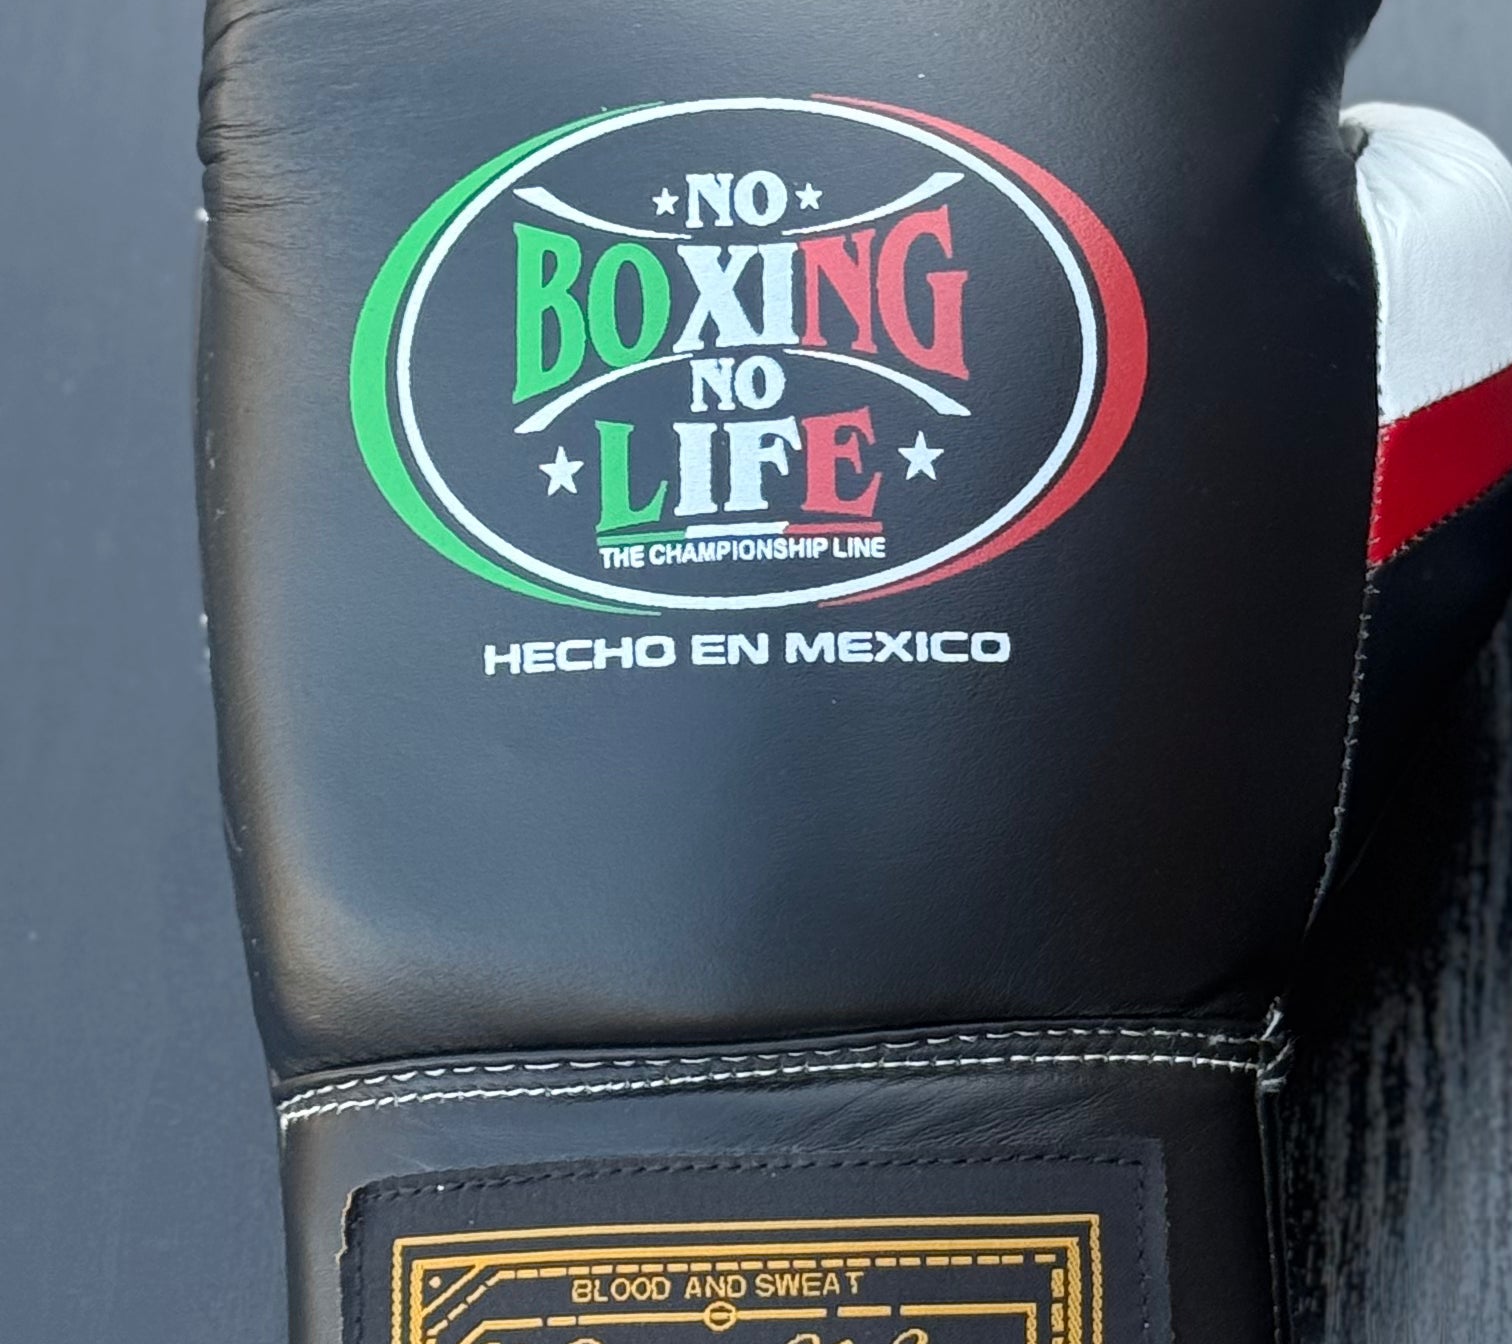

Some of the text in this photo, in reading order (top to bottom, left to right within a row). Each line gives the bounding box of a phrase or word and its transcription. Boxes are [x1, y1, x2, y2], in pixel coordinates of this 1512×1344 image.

[685, 170, 788, 228] NO
[512, 205, 970, 404] BOXING
[690, 354, 786, 412] NO
[595, 407, 882, 532] LIFE
[600, 536, 886, 569] THE CHAMPIONSHIP LINE
[484, 631, 1011, 676] HECHO EN MEXICO
[571, 1271, 864, 1303] BLOOD AND SWEAT
